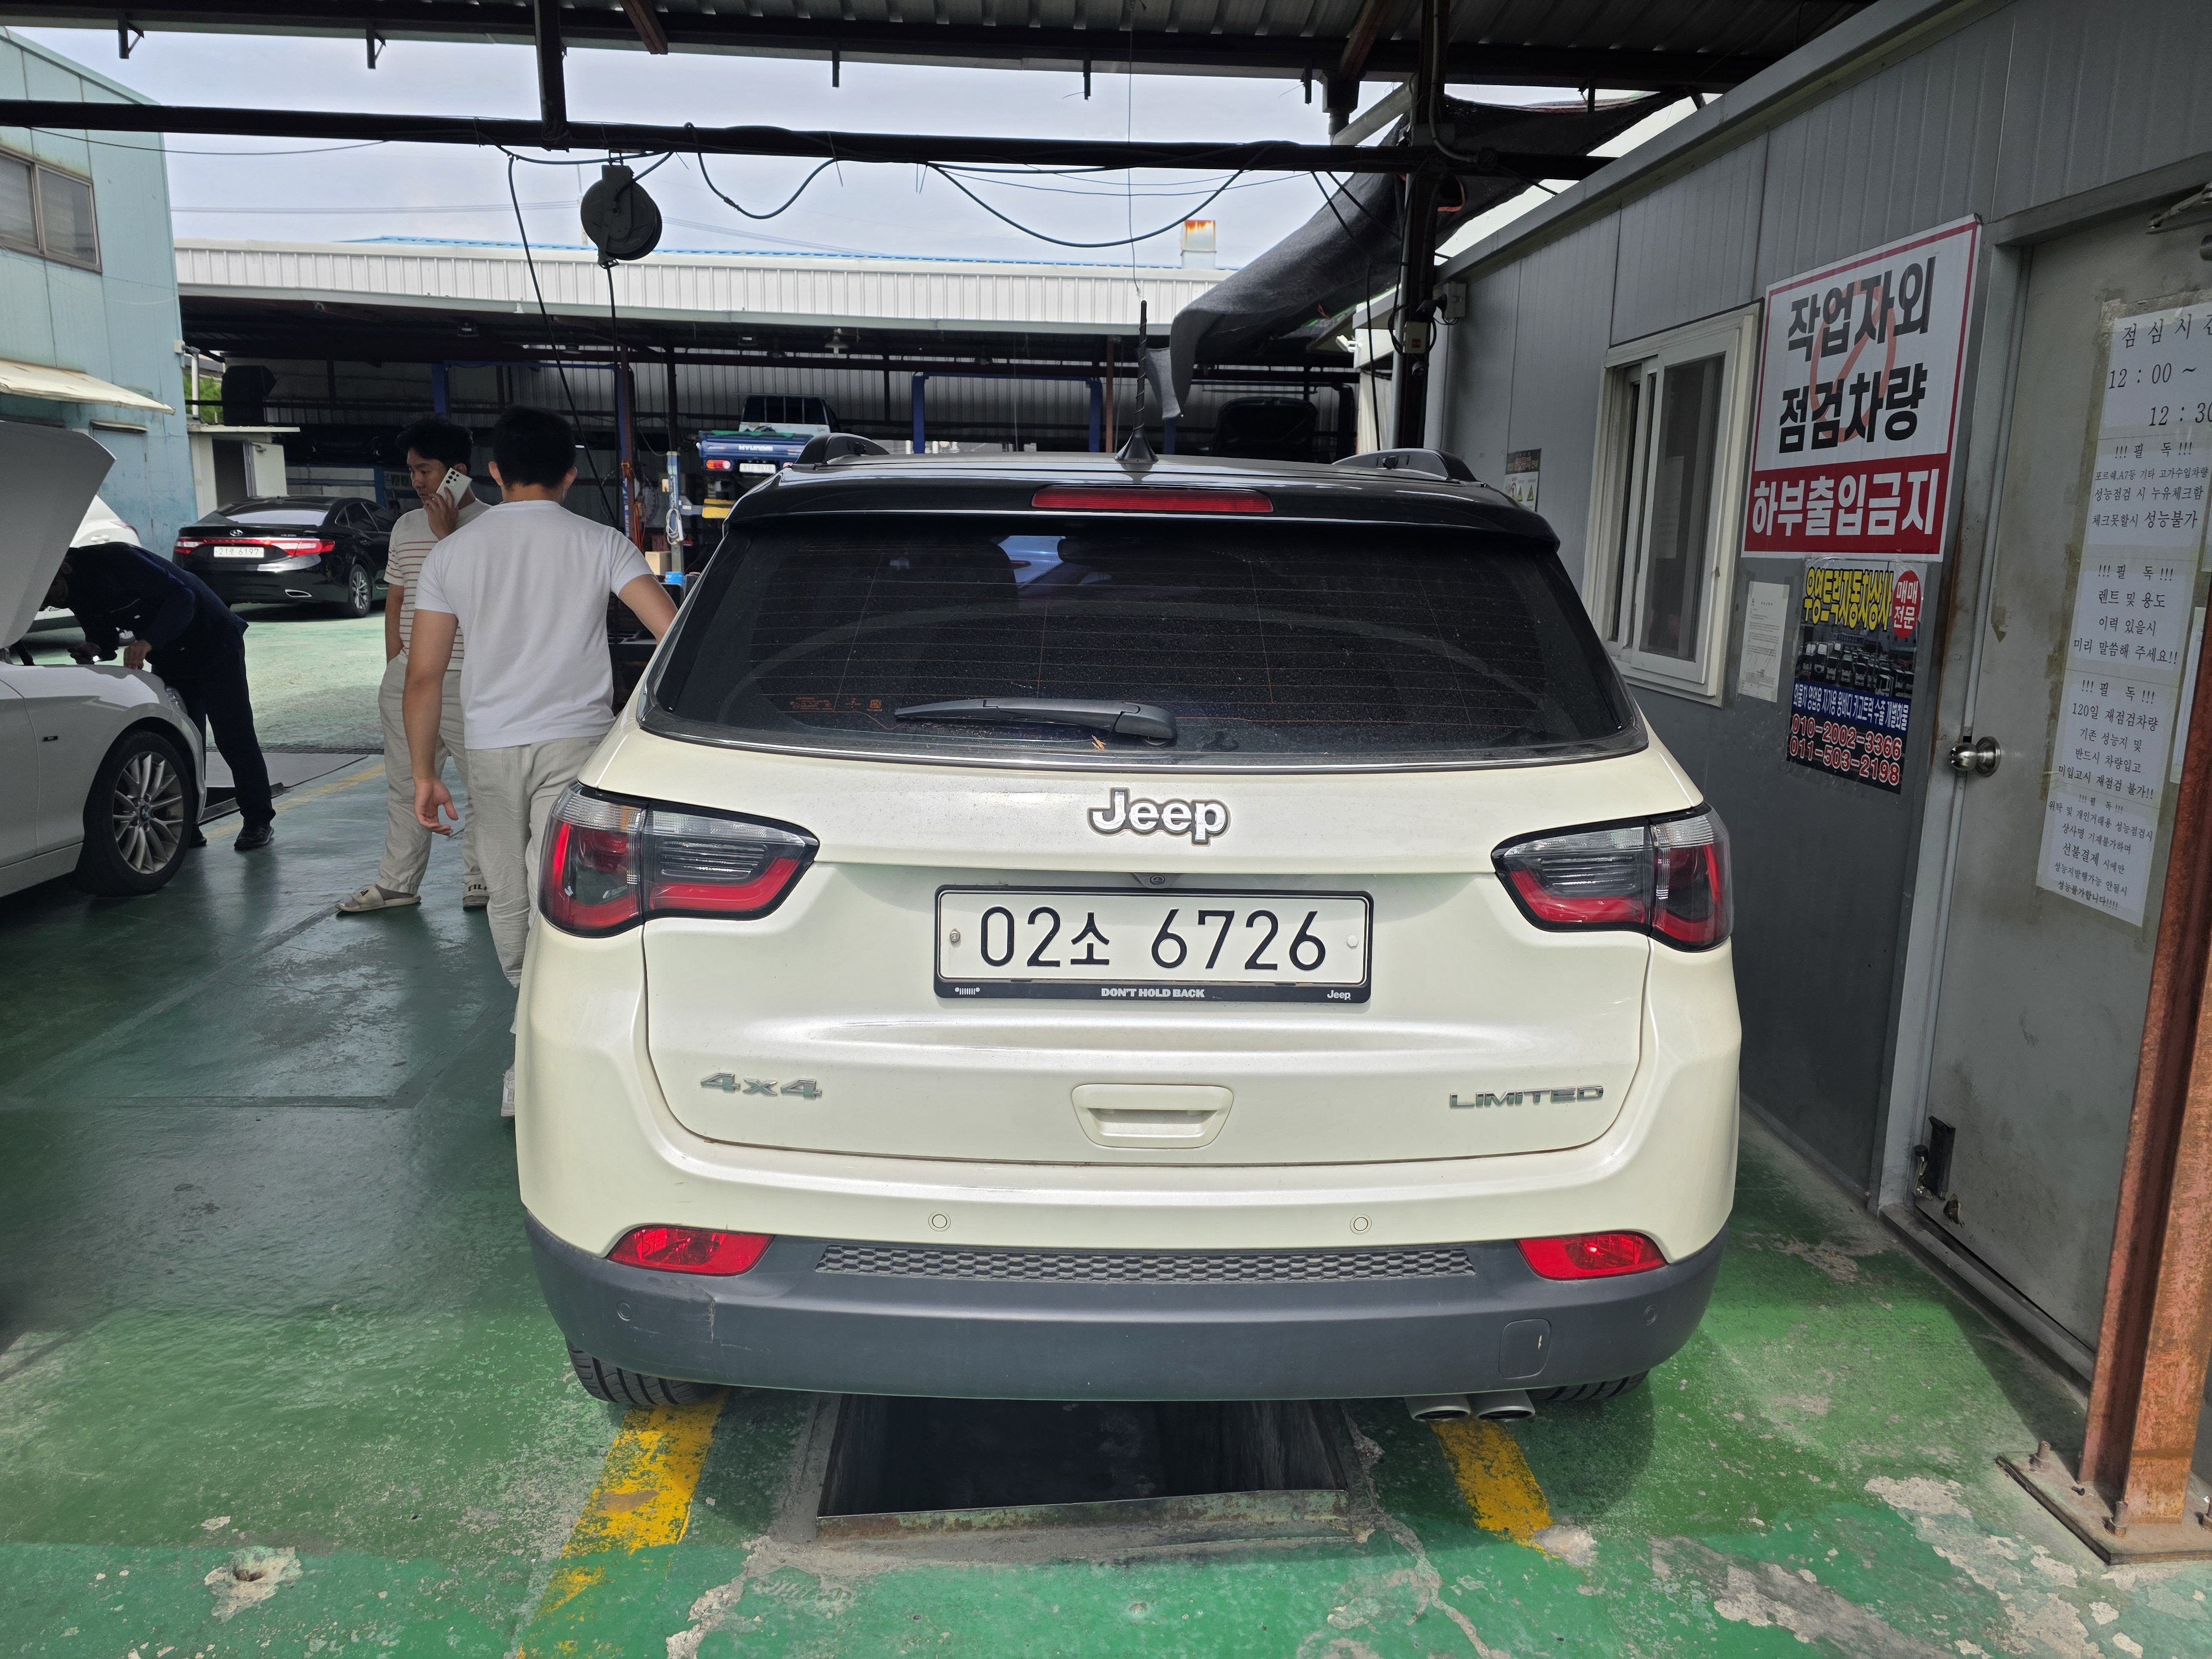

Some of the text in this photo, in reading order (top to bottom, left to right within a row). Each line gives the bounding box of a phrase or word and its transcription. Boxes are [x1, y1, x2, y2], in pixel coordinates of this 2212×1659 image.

[1787, 255, 1936, 362] 작업자외
[1778, 362, 1927, 453] 점검차량
[2095, 466, 2209, 481] 포르쉐,A7등 기타 고가수입차량
[1752, 468, 1939, 536] 하부출입금지
[2094, 486, 2203, 502] 성능점검 시 누유체크함
[2092, 510, 2198, 529] 체크못할시 성능불가
[1896, 580, 1919, 604] 매매
[2099, 589, 2166, 608] 렌트 및 용도
[1893, 606, 1915, 630] 전문
[2099, 616, 2156, 637] 이력 있을시
[2074, 638, 2177, 664] 미리 말씀해 주세요!!
[1793, 683, 1908, 731] 화물차 영업용 자가용 윙바디 카고트럭 수출 개별화물
[2072, 703, 2158, 732] 120일 재점검차량
[1792, 713, 1902, 761] 010-2002-3366
[2079, 727, 2142, 753] 기존 성능지 및
[1790, 735, 1900, 786] 011-503-2198
[2075, 748, 2141, 773] 반드시 차량입고
[2058, 765, 2153, 799] 미입고시 재점검 불가!!
[1089, 788, 1230, 844] Jeep
[2048, 800, 2153, 842] 위탁 및 개인거래용 성능점검시
[2062, 823, 2131, 854] 상사명 기재불가하며
[2062, 843, 2125, 874] 선불결제 시에만
[2054, 862, 2102, 886] 성능지발행가능
[980, 906, 1327, 972] 02소 6726
[1101, 988, 1205, 998] DON'T HOLD BACK
[1327, 989, 1351, 1000] Jeep
[700, 1071, 822, 1099] 4x4
[1449, 1084, 1604, 1108] LIMITED
